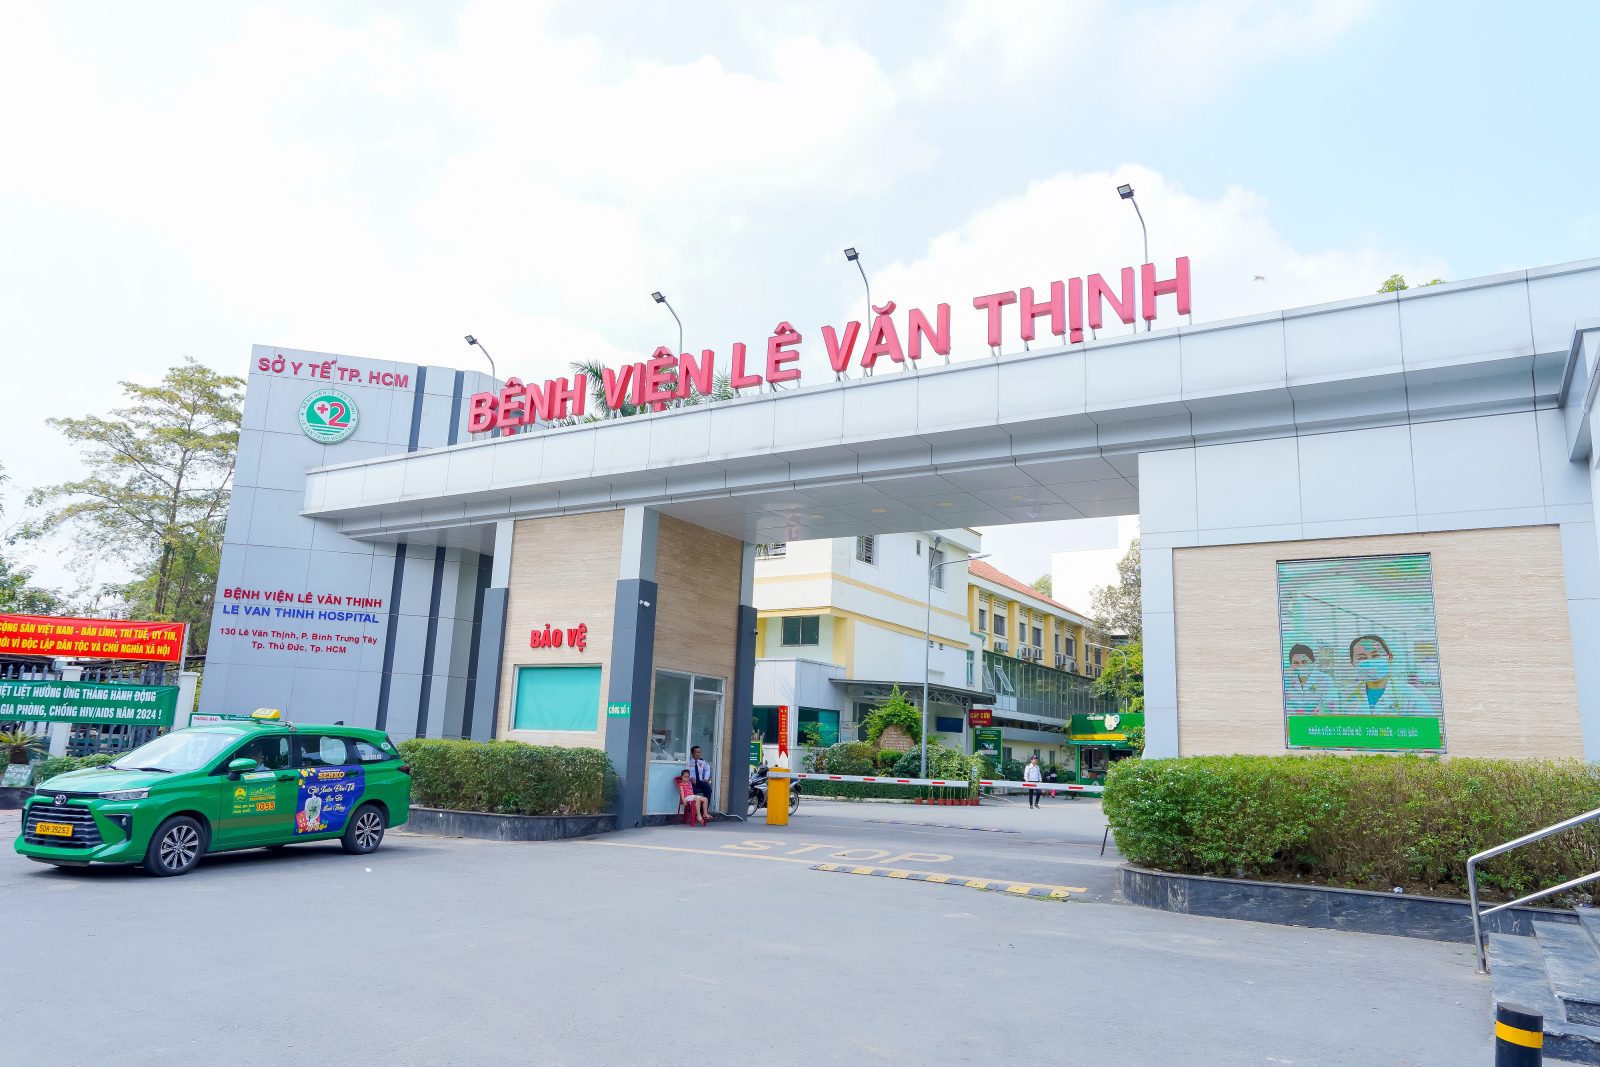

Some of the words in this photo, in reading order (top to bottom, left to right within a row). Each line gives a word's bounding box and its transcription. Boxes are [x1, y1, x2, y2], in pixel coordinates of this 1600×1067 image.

[467, 373, 587, 437] BỆNH
[602, 345, 715, 412] VIỆN
[731, 322, 803, 389] LÊ
[821, 300, 952, 374] VĂN
[973, 255, 1192, 347] THỊNH
[258, 354, 286, 374] SỞ
[291, 361, 303, 375] Y
[308, 360, 337, 379] TẾ
[337, 366, 362, 382] TP.
[368, 370, 409, 388] HCM
[329, 402, 349, 428] 2
[223, 587, 260, 600] BỆNH
[264, 590, 294, 604] VIỆN
[297, 592, 313, 604] LÊ
[317, 594, 342, 605] VĂN
[346, 596, 382, 608] THỊNH
[222, 604, 239, 614] LE
[244, 606, 270, 616] VAN
[275, 608, 314, 620] THINH
[318, 611, 379, 624] HOSPITAL
[20, 622, 36, 633] SẢN
[38, 623, 54, 636] VIỆT
[56, 625, 74, 635] NAM
[81, 625, 97, 636] BẢN
[98, 626, 118, 638] LÍNH,
[120, 627, 133, 638] TRÍ
[220, 628, 236, 636] 130
[238, 628, 249, 636] Lê
[252, 629, 268, 638] Văn
[271, 630, 299, 640] Thịnh,
[336, 634, 360, 644] Trưng
[363, 636, 378, 644] Tây
[530, 624, 563, 648] BẢO
[567, 623, 587, 652] VỆ
[12, 636, 20, 648] VÌ
[21, 637, 38, 650] ĐỘC
[40, 638, 54, 651] LẬP
[56, 639, 72, 650] DÂN
[74, 640, 89, 652] TỘC
[103, 641, 119, 652] CHỦ
[121, 643, 143, 654] NGHĨA
[157, 644, 170, 656] HỘI
[252, 641, 264, 650] Tp.
[268, 642, 284, 650] Thủ
[287, 642, 307, 652] Đức,
[310, 644, 324, 653] Tp.
[326, 645, 346, 654] HCM
[13, 684, 32, 699] LIỆT
[63, 685, 80, 699] ỨNG
[82, 686, 108, 700] THÁNG
[110, 688, 133, 701] HÀNH
[134, 688, 157, 703] ĐỘNG
[0, 704, 14, 715] GIA
[16, 702, 47, 717] PHÒNG,
[49, 702, 78, 717] CHỐNG
[80, 706, 114, 718] HIV/AIDS
[116, 706, 135, 718] NĂM
[136, 709, 156, 719] 2024
[256, 801, 275, 811] 1055
[720, 840, 954, 864] STOP
